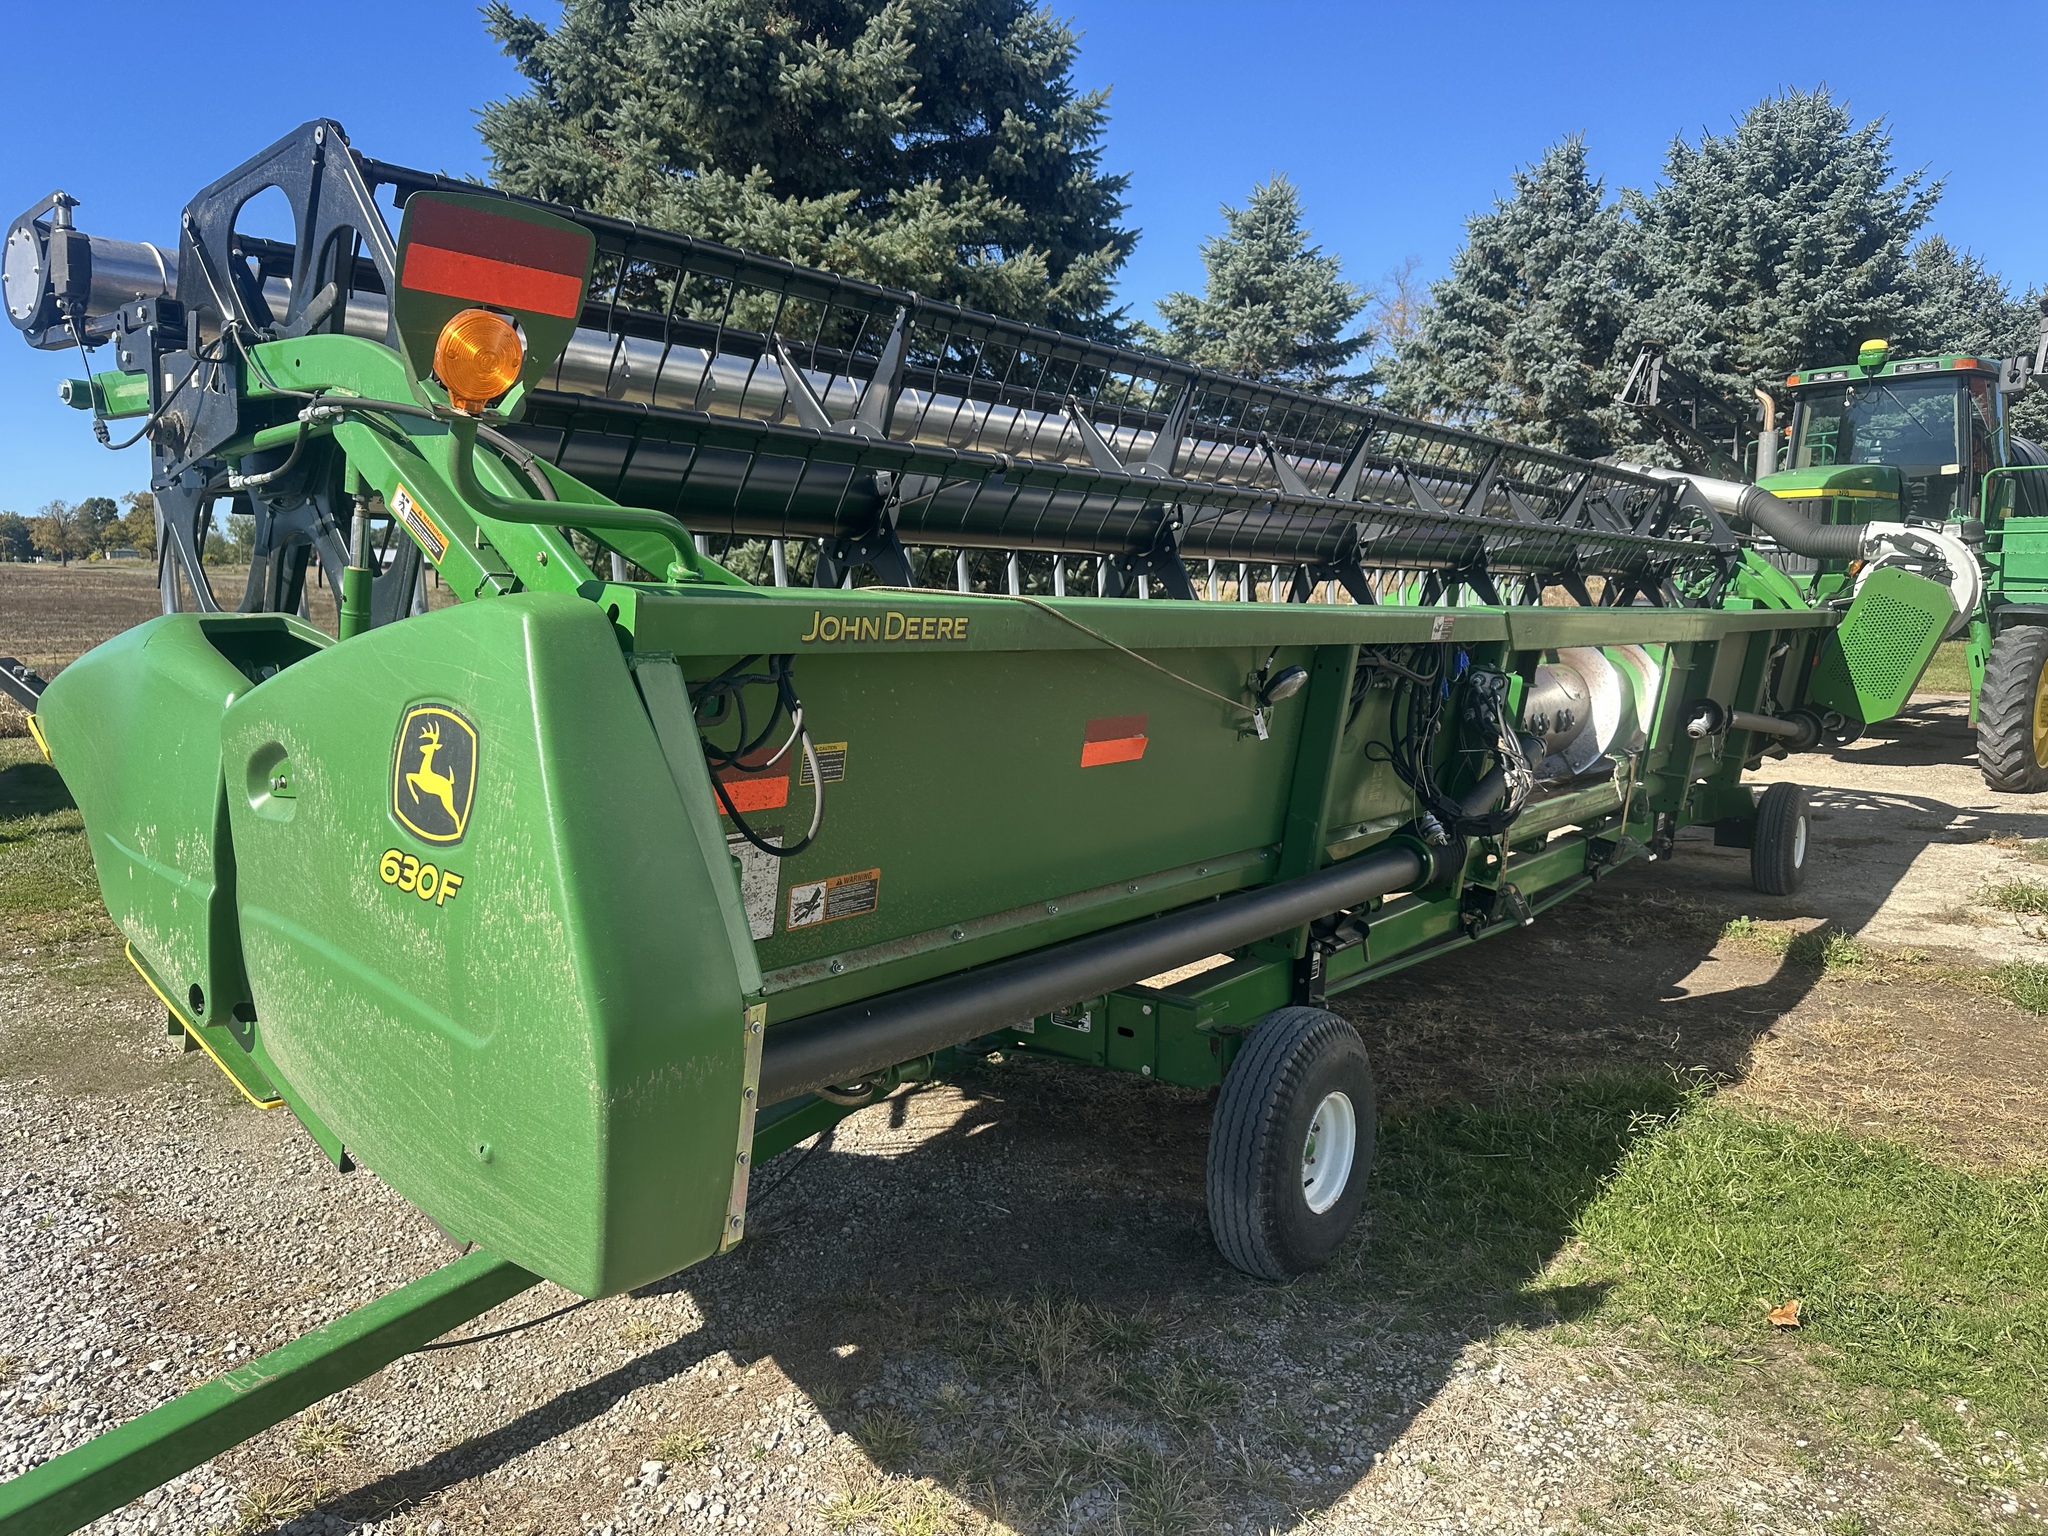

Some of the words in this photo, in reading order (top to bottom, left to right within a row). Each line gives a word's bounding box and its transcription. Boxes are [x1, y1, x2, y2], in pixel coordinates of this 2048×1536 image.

[423, 515, 443, 540] WARNING
[801, 610, 880, 642] JOHN
[883, 611, 969, 641] DEERE
[379, 847, 464, 908] 630F
[844, 871, 873, 884] WARNING
